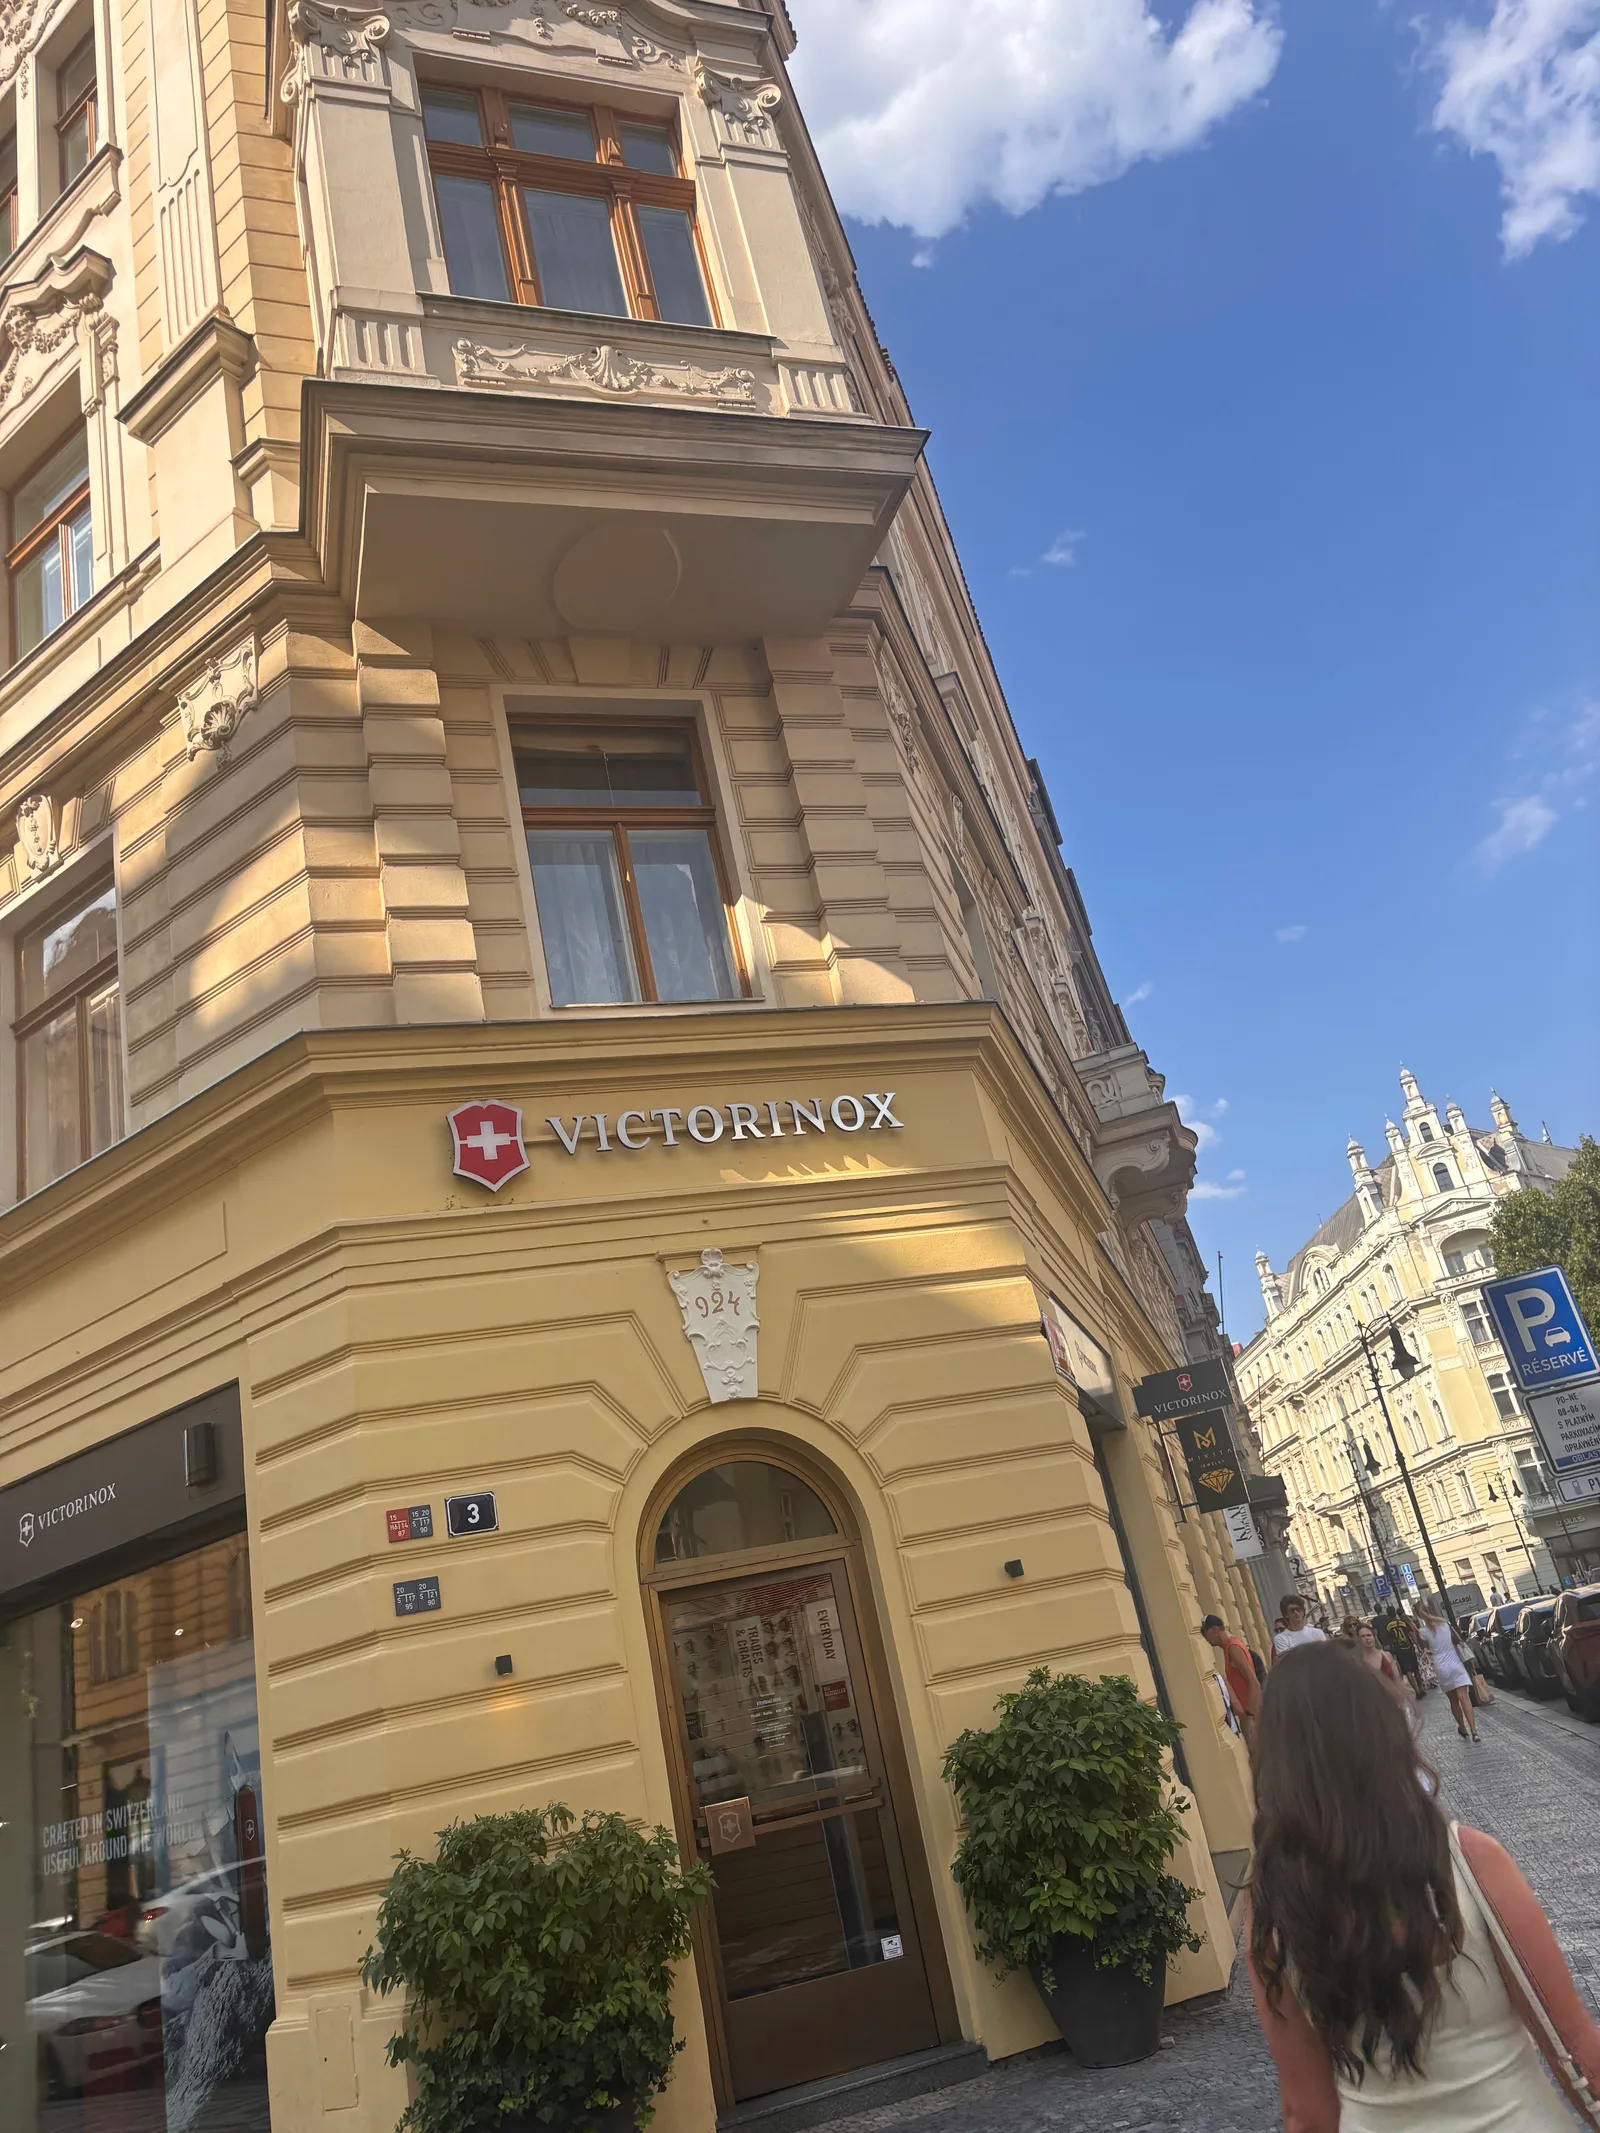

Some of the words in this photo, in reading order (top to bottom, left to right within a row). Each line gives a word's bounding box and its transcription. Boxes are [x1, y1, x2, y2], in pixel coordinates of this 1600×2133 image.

[545, 1092, 905, 1155] VICTORINOX
[695, 1290, 741, 1319] 924
[1504, 1287, 1556, 1353] P
[1521, 1346, 1589, 1376] RÉSERVÉ
[1153, 1388, 1228, 1414] VICTORINOX
[1556, 1392, 1579, 1405] PO-NE
[1557, 1420, 1564, 1430] S
[37, 1482, 117, 1531] VICTORINOX
[421, 1509, 430, 1517] 20
[467, 1502, 480, 1524] 3
[397, 1529, 406, 1537] 87
[396, 1586, 405, 1595] 20
[418, 1582, 427, 1590] 20
[427, 1598, 436, 1606] 90
[735, 1628, 746, 1637] &
[747, 1624, 764, 1665] TRADES
[817, 1608, 837, 1660] EVERYDAY
[737, 1639, 753, 1679] CRAFTS
[43, 1816, 89, 1848] CRAFTED
[92, 1813, 103, 1836] IN
[43, 1846, 82, 1877] USEFUL
[84, 1834, 128, 1867] AROUND
